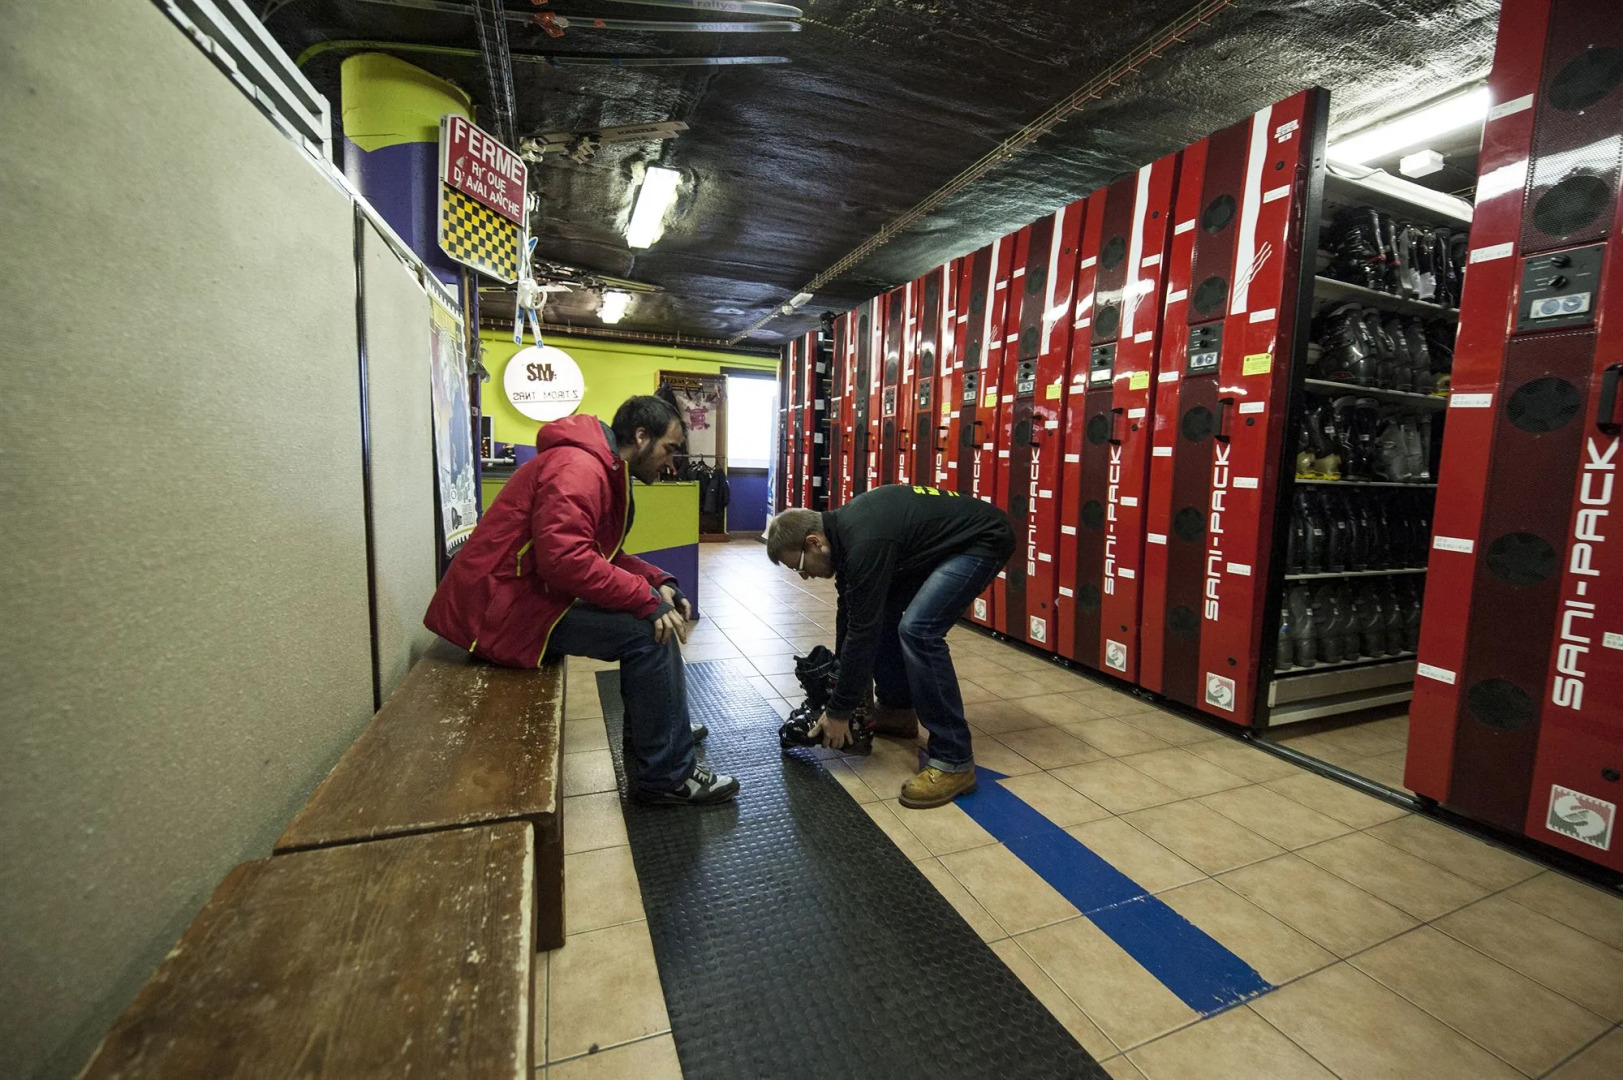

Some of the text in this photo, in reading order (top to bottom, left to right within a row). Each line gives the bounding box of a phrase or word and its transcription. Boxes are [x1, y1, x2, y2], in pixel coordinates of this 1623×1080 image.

[455, 118, 522, 186] FERME
[1027, 448, 1041, 577] SANI-PACK
[1104, 446, 1122, 596] SANI-PACK
[1205, 443, 1231, 622] SANI-PACK
[1552, 436, 1620, 711] SANI-PACK
